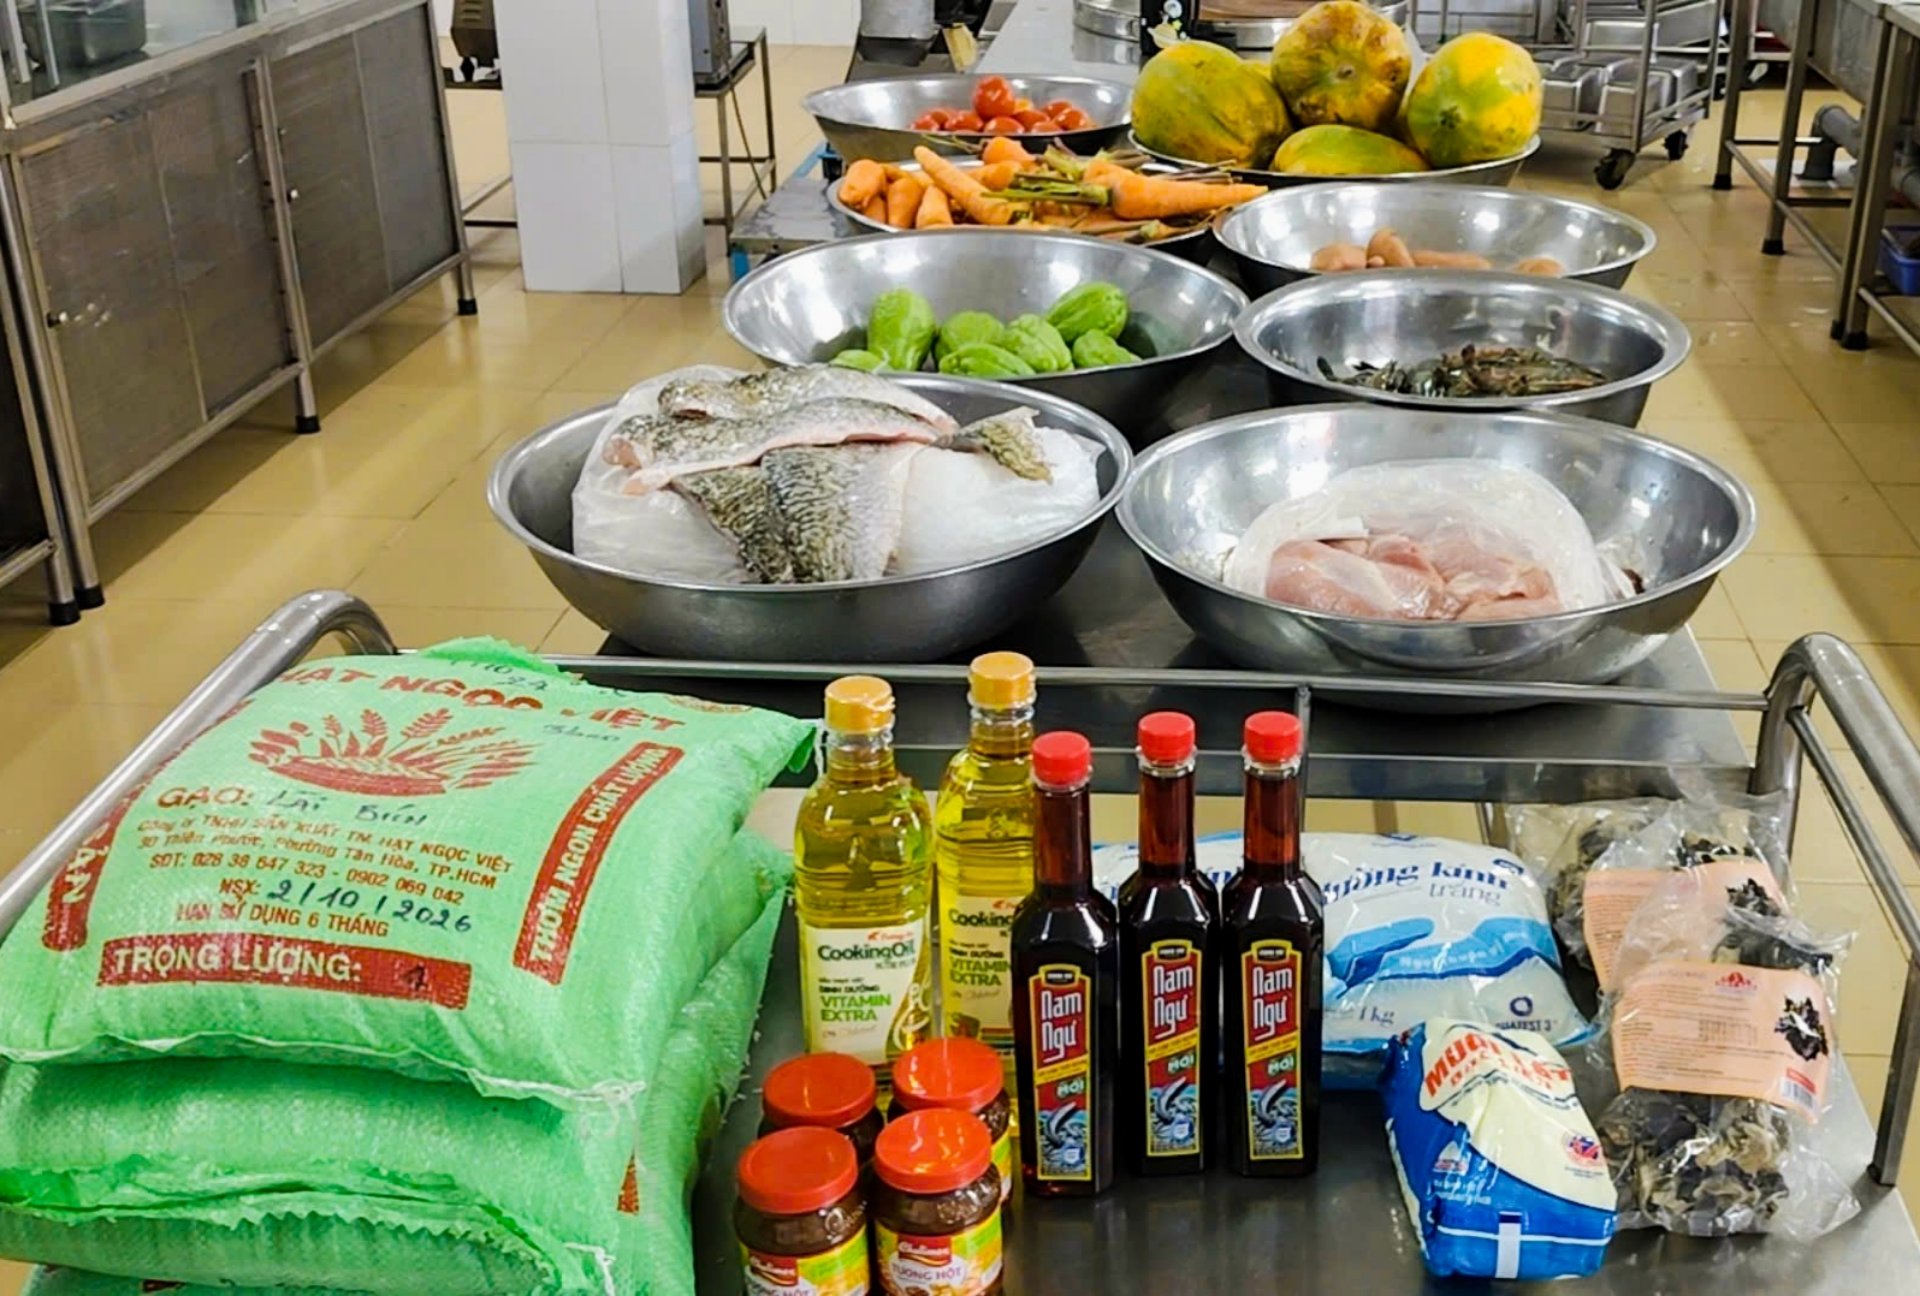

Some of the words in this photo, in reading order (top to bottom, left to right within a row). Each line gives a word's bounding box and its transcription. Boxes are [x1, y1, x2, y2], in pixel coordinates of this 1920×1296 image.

[157, 786, 254, 810] GẠO:
[553, 823, 598, 887] NGON
[583, 782, 629, 823] CHẤT
[419, 842, 471, 863] NGỌC
[475, 851, 515, 874] VIỆT
[192, 851, 224, 867] 028
[256, 855, 288, 872] 647
[294, 861, 327, 879] 323
[346, 868, 390, 888] 0902
[395, 877, 427, 897] 069
[432, 886, 465, 906] 042
[429, 861, 498, 889] TP.HCM
[250, 903, 303, 927] DỤNG
[307, 912, 320, 928] 6
[327, 911, 391, 937] THÁNG
[113, 943, 220, 978] TRỌNG
[232, 942, 362, 983] LƯỢNG:
[950, 969, 1002, 986] EXTRA
[1153, 965, 1193, 996] Nam
[1252, 966, 1293, 997] Nam
[820, 994, 892, 1008] VITAMIN
[820, 1008, 878, 1021] EXTRA
[1041, 990, 1082, 1020] Nam
